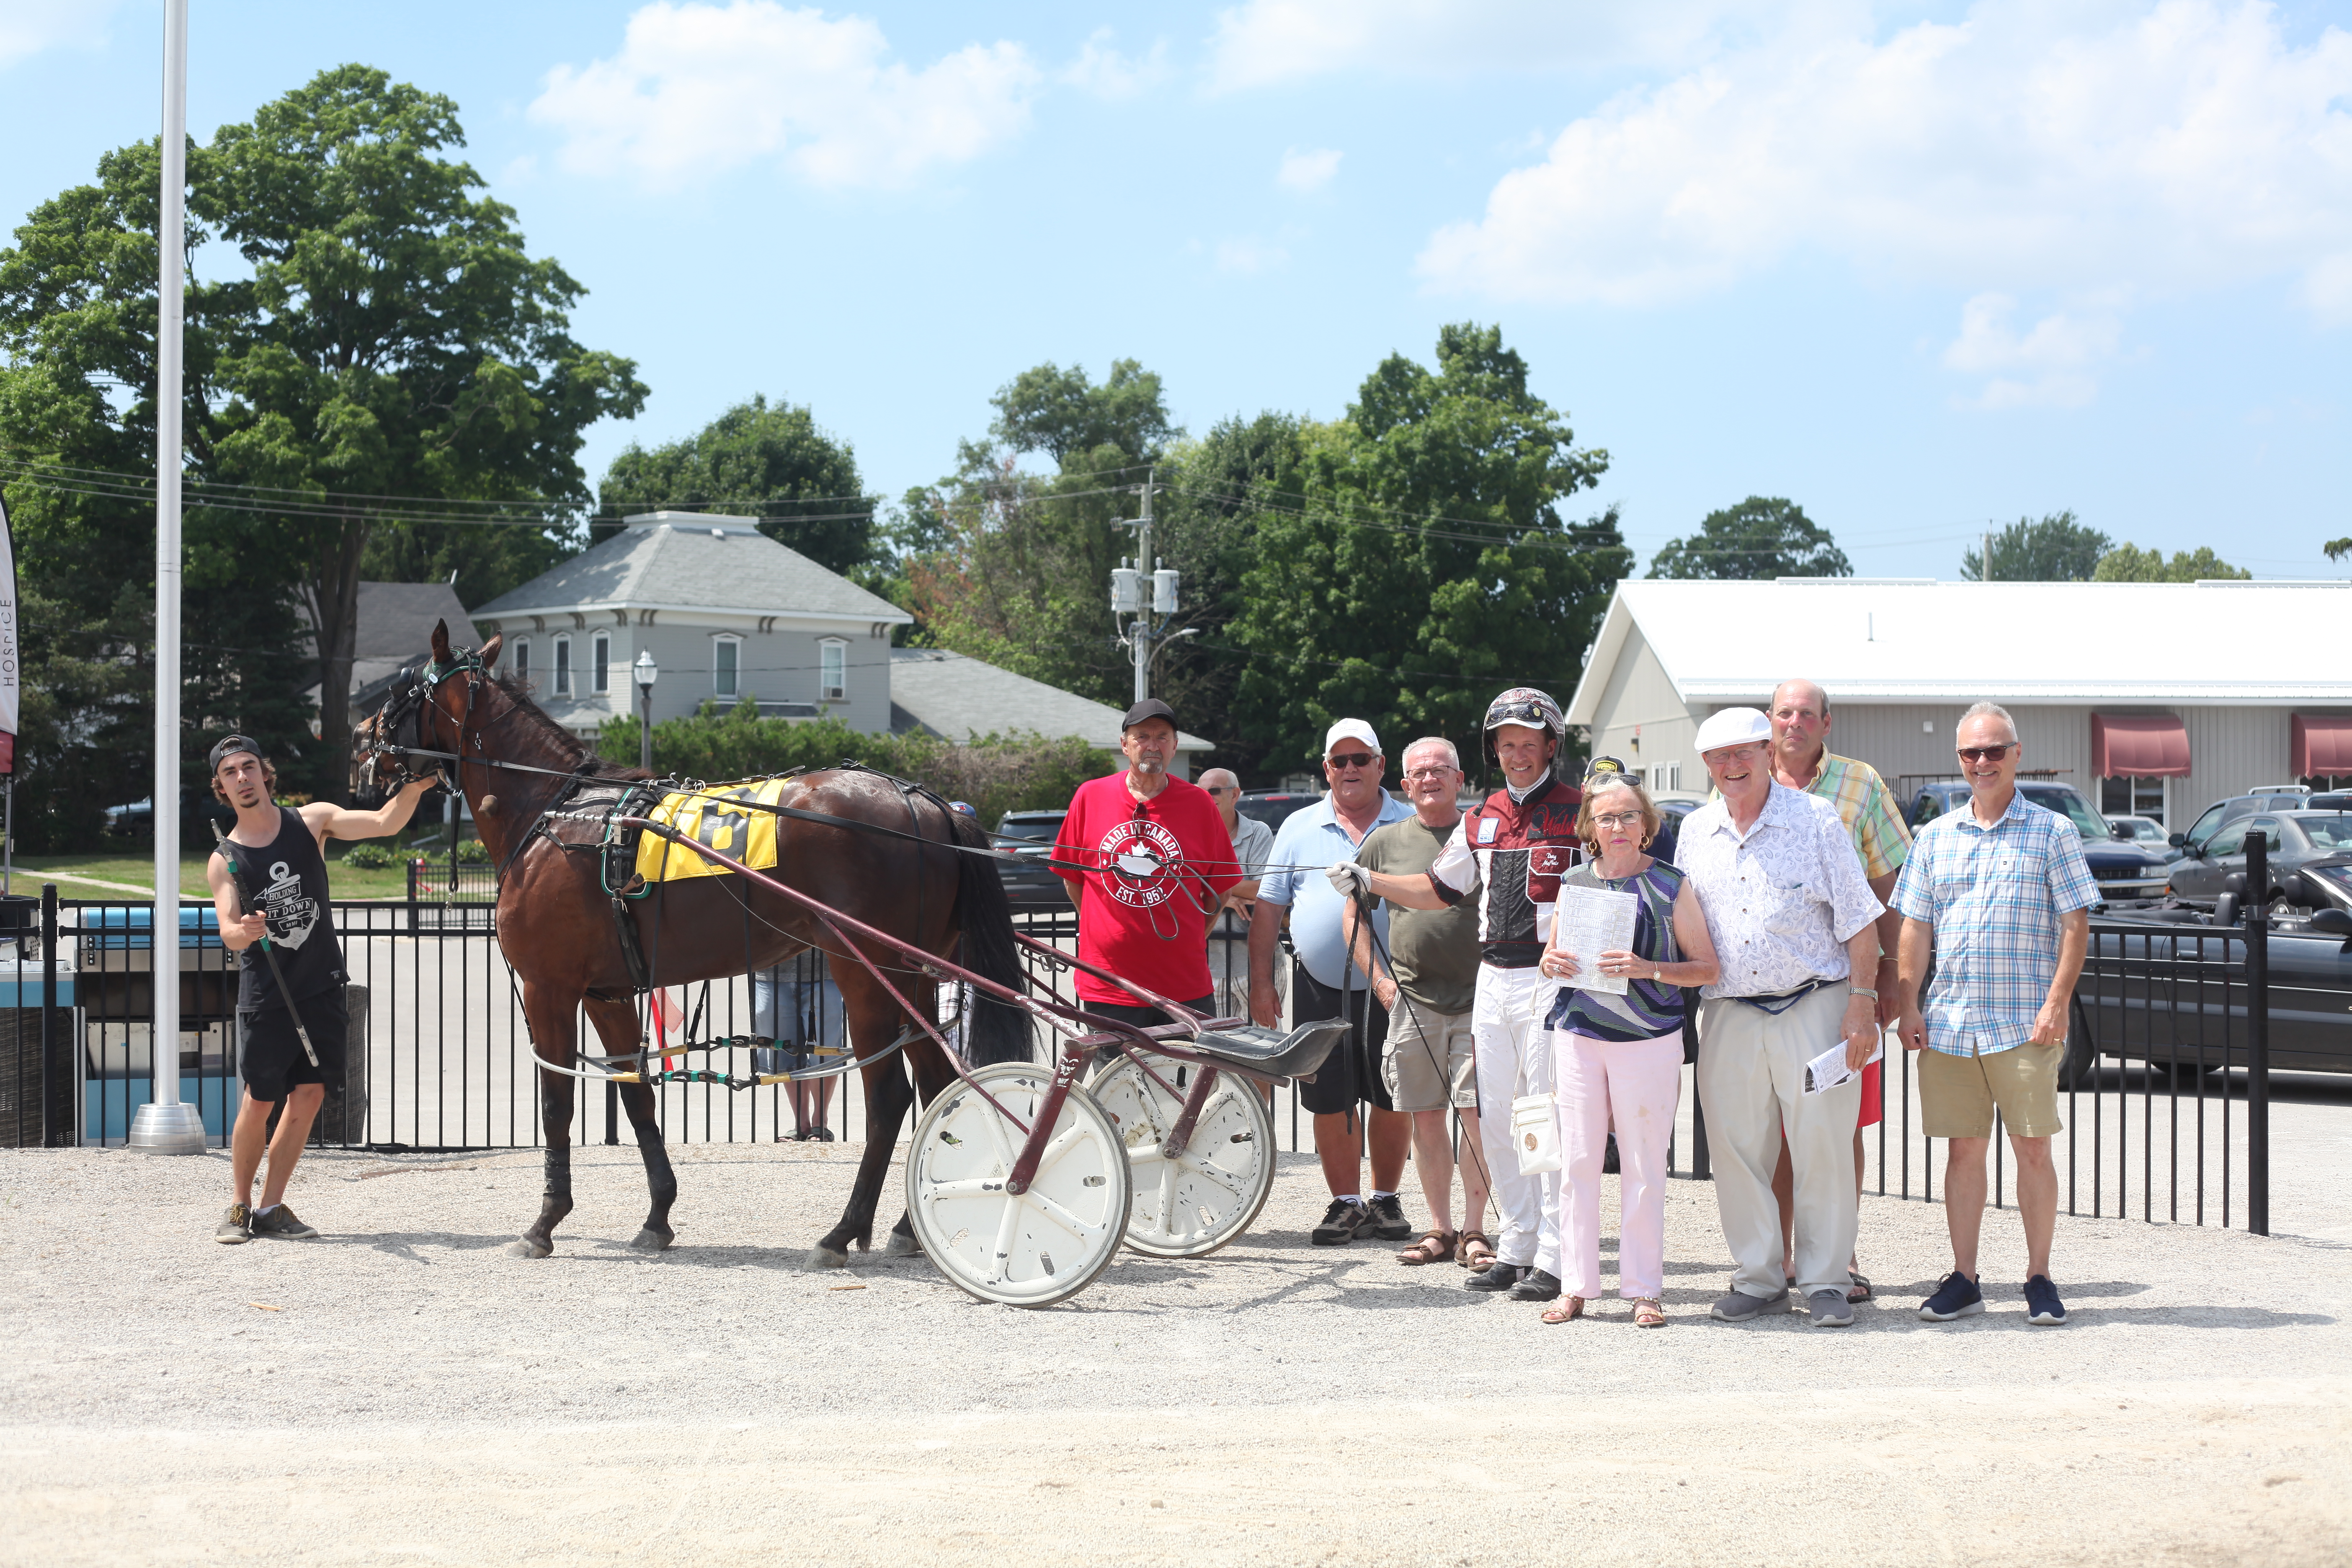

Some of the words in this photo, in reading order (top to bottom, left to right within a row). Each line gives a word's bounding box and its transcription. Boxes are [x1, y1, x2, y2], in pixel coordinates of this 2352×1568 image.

[0, 600, 14, 686] HOSPICE
[699, 787, 755, 866] 6
[1101, 826, 1129, 852] MADE
[1130, 823, 1140, 835] IN
[1144, 823, 1179, 858] CANADA
[269, 886, 297, 901] HOLDING
[1115, 886, 1136, 904] EST.
[268, 910, 279, 918] IT
[282, 900, 310, 916] DOWN
